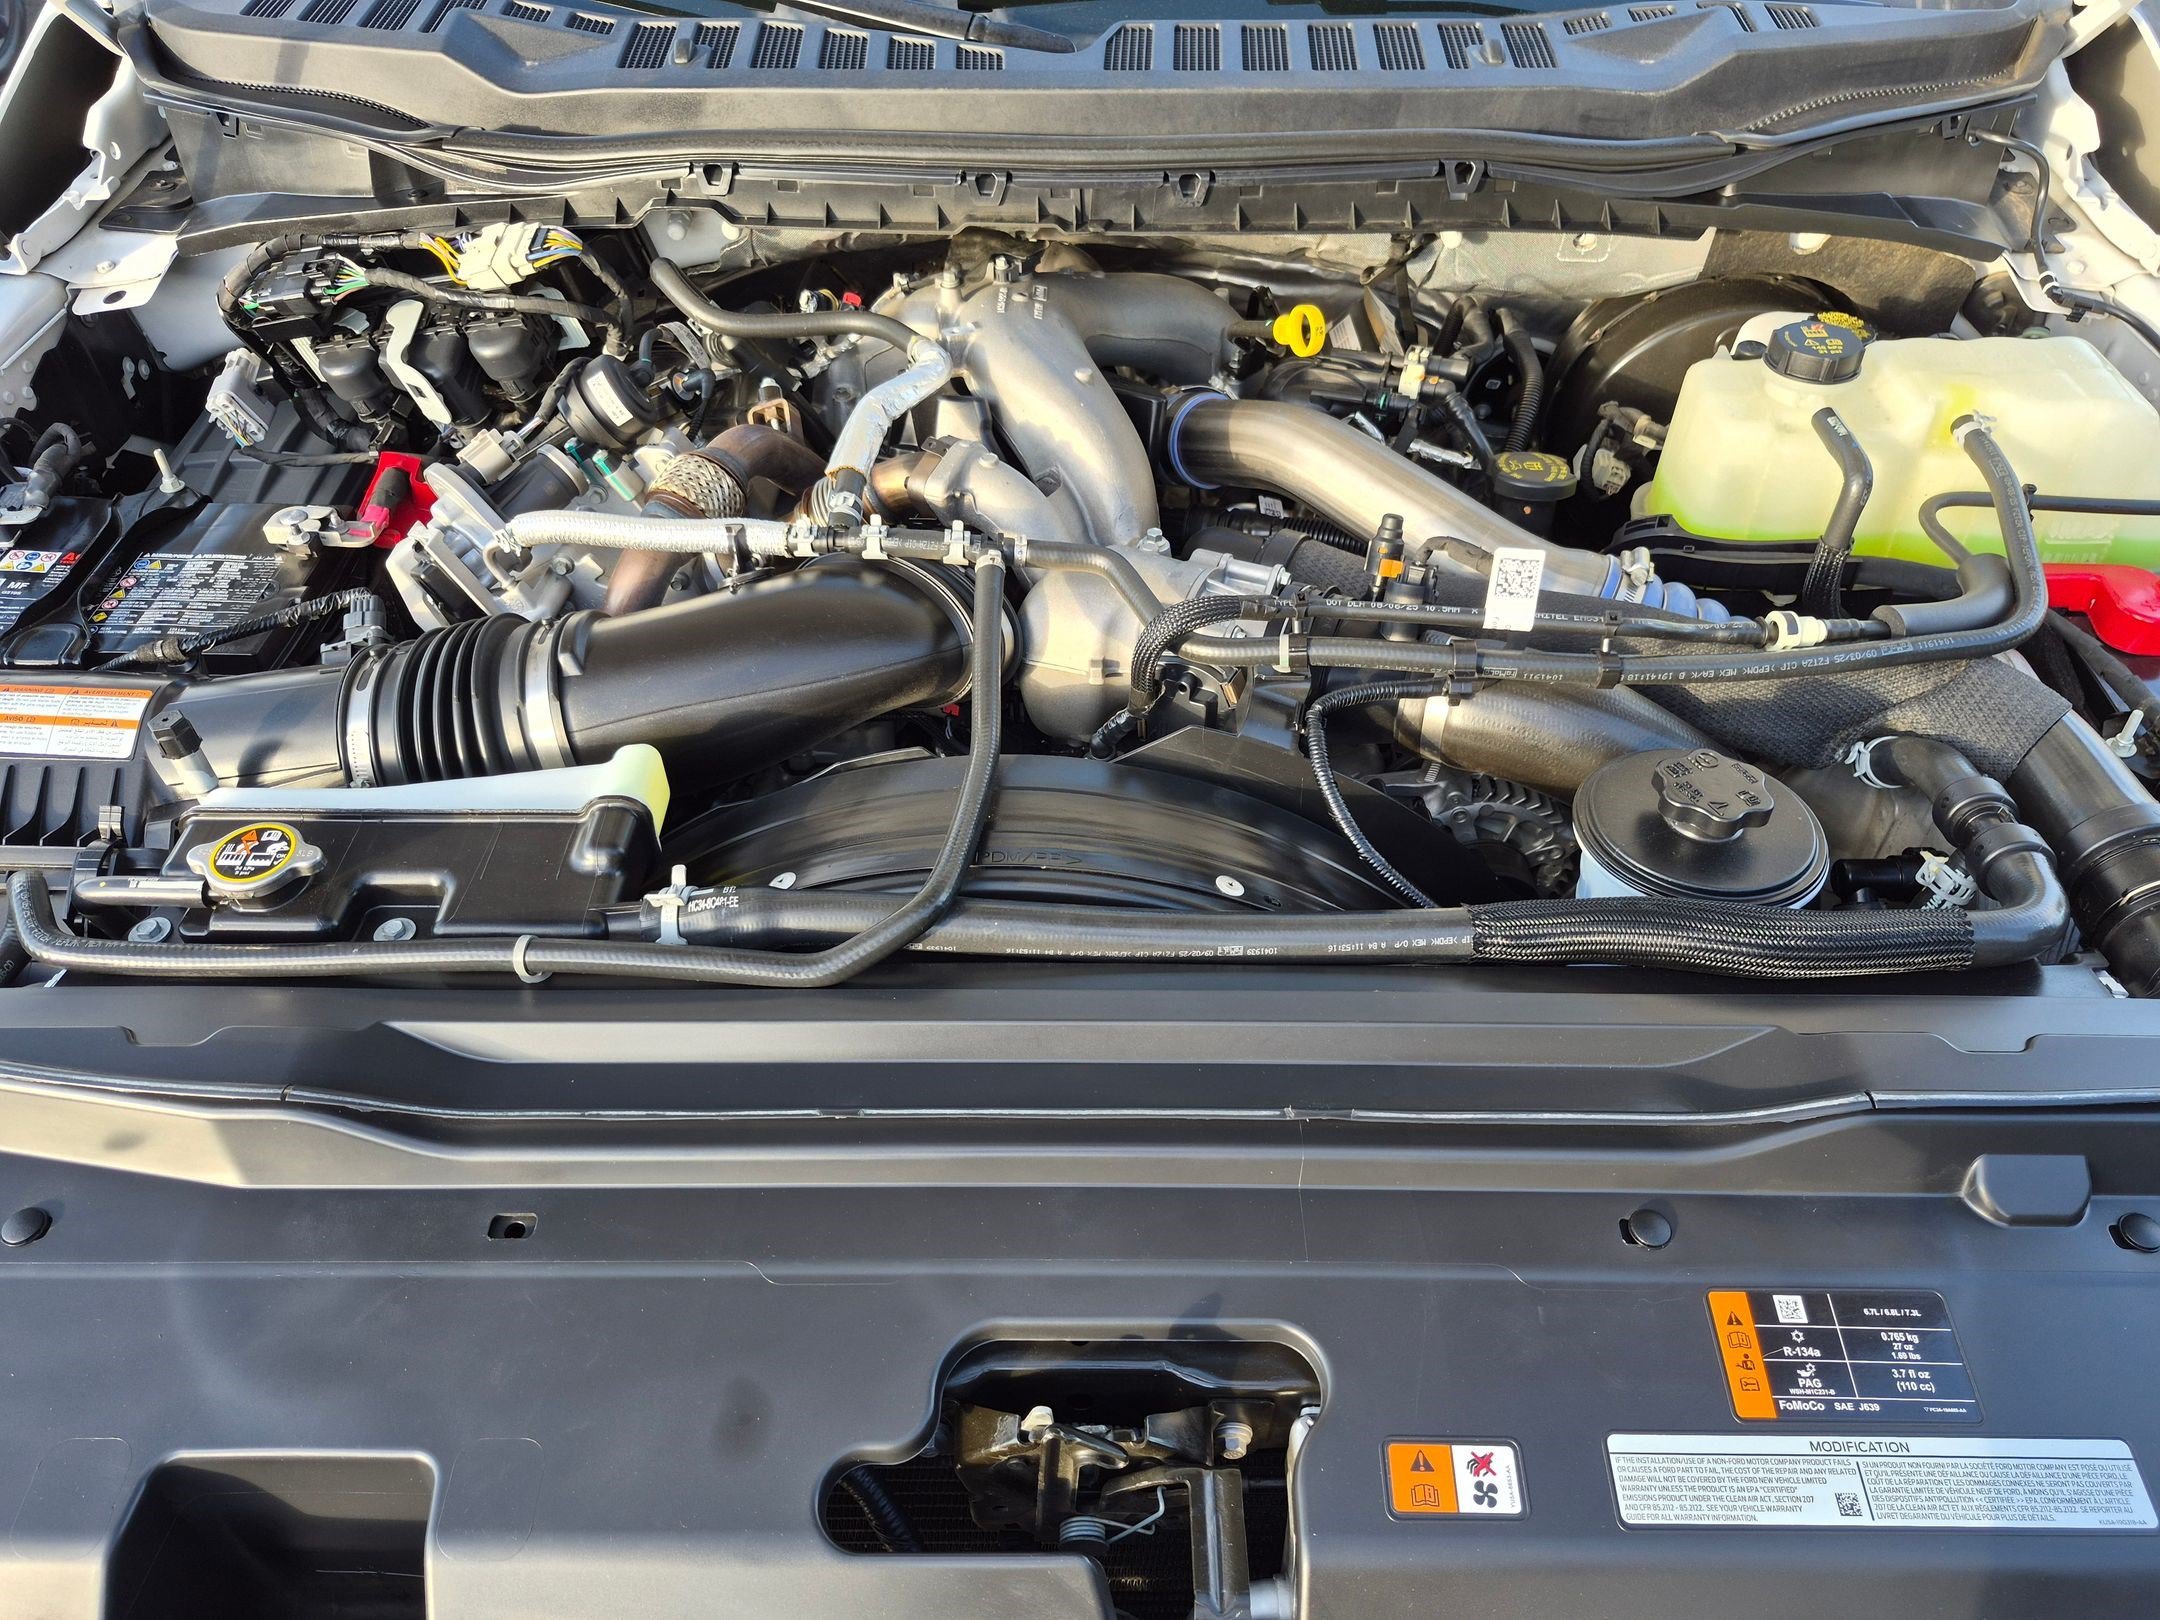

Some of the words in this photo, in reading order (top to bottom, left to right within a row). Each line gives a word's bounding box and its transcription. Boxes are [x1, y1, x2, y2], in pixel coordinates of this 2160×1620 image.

[1919, 638, 1954, 647] 1041911
[1834, 650, 1877, 663] 09/03/25
[1719, 668, 1736, 676] MEX
[1328, 944, 1364, 952] 11:53:16
[1880, 1332, 1905, 1341] 0.765
[1906, 1332, 1919, 1344] kg
[1783, 1346, 1821, 1357] R-134a
[1891, 1369, 1906, 1378] 3.7
[1908, 1369, 1916, 1378] fl
[1798, 1378, 1822, 1388] PAG
[1897, 1381, 1917, 1392] (110
[1920, 1382, 1935, 1393] cc)
[1779, 1400, 1825, 1411] FoMoCo
[1834, 1402, 1854, 1411] SAE
[1859, 1403, 1880, 1411] J639
[1809, 1441, 1910, 1453] MODIFICATION
[1878, 1461, 1908, 1469] PRODUIT
[2035, 1462, 2068, 1470] COMPANY
